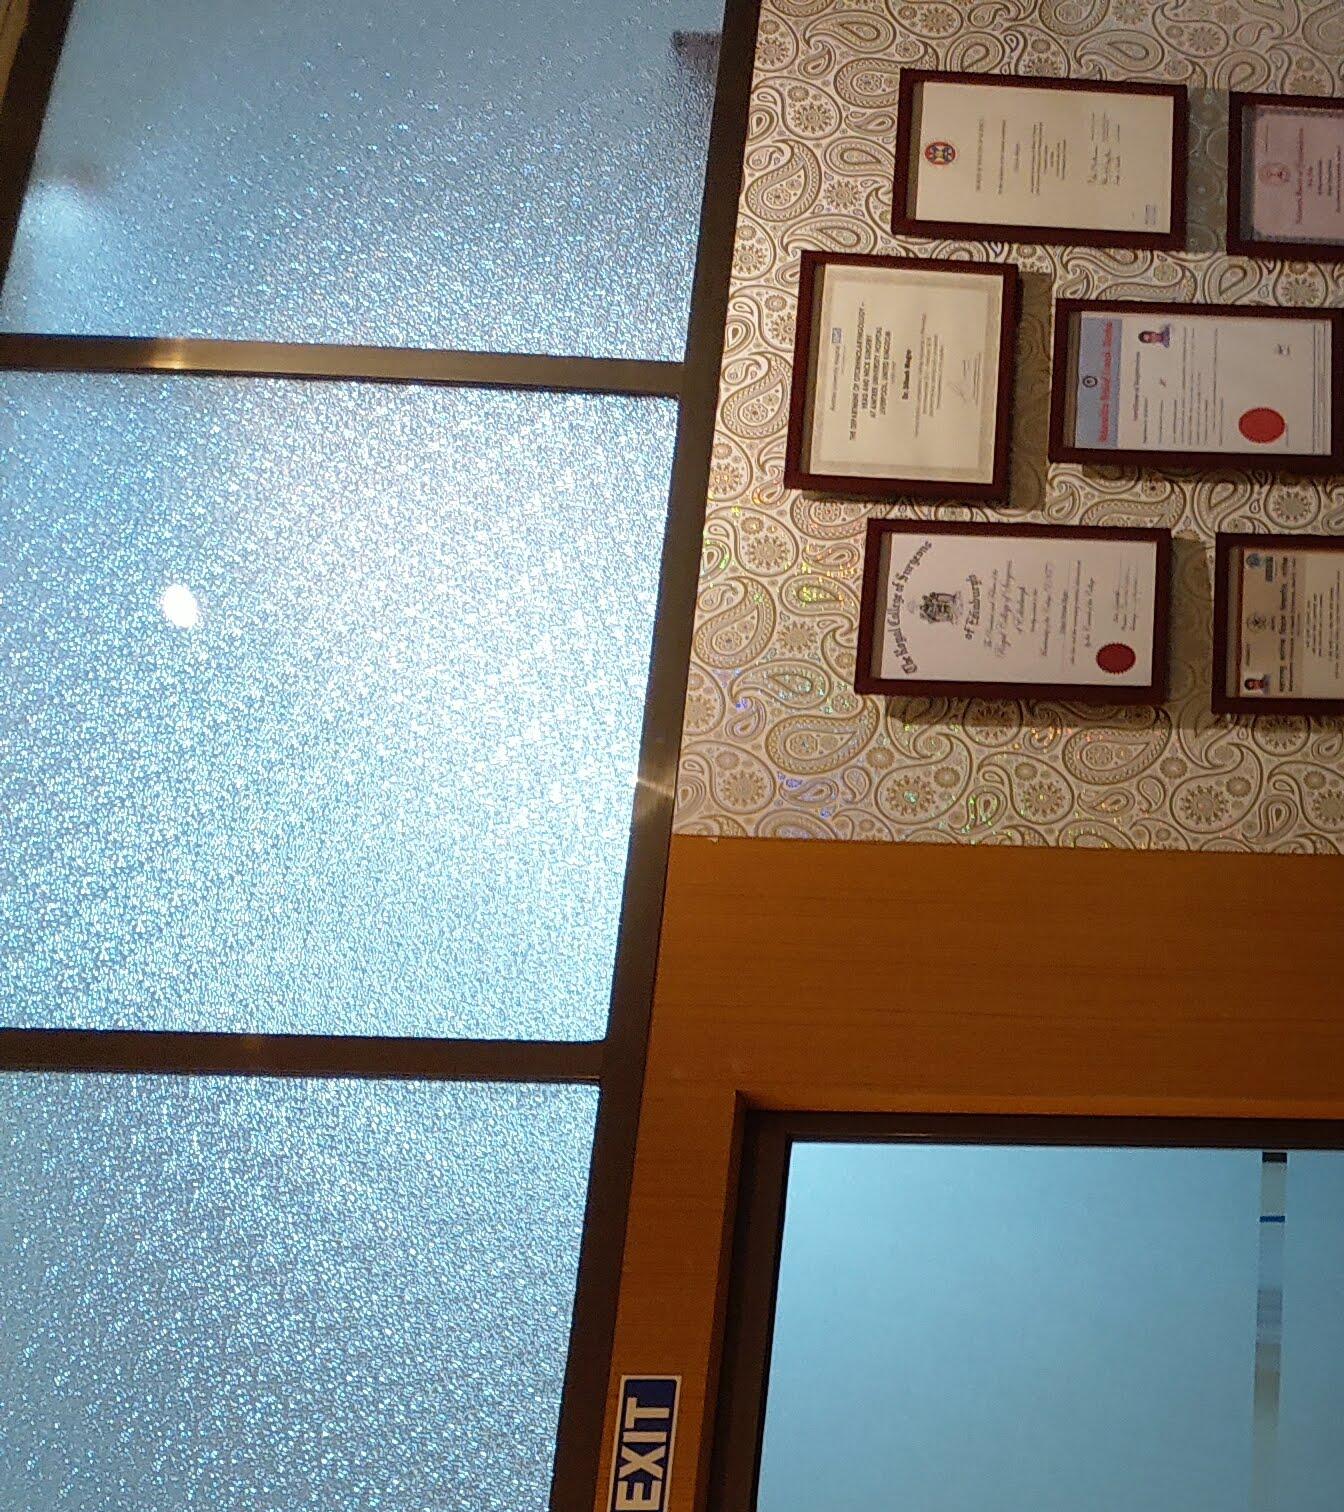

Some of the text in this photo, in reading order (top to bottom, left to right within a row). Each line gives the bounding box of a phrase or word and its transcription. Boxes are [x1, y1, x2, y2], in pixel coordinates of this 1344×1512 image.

[887, 540, 933, 674] The Royal College of Surgeons
[963, 574, 982, 640] of Edinburgh
[615, 1397, 670, 1511] EXIT
